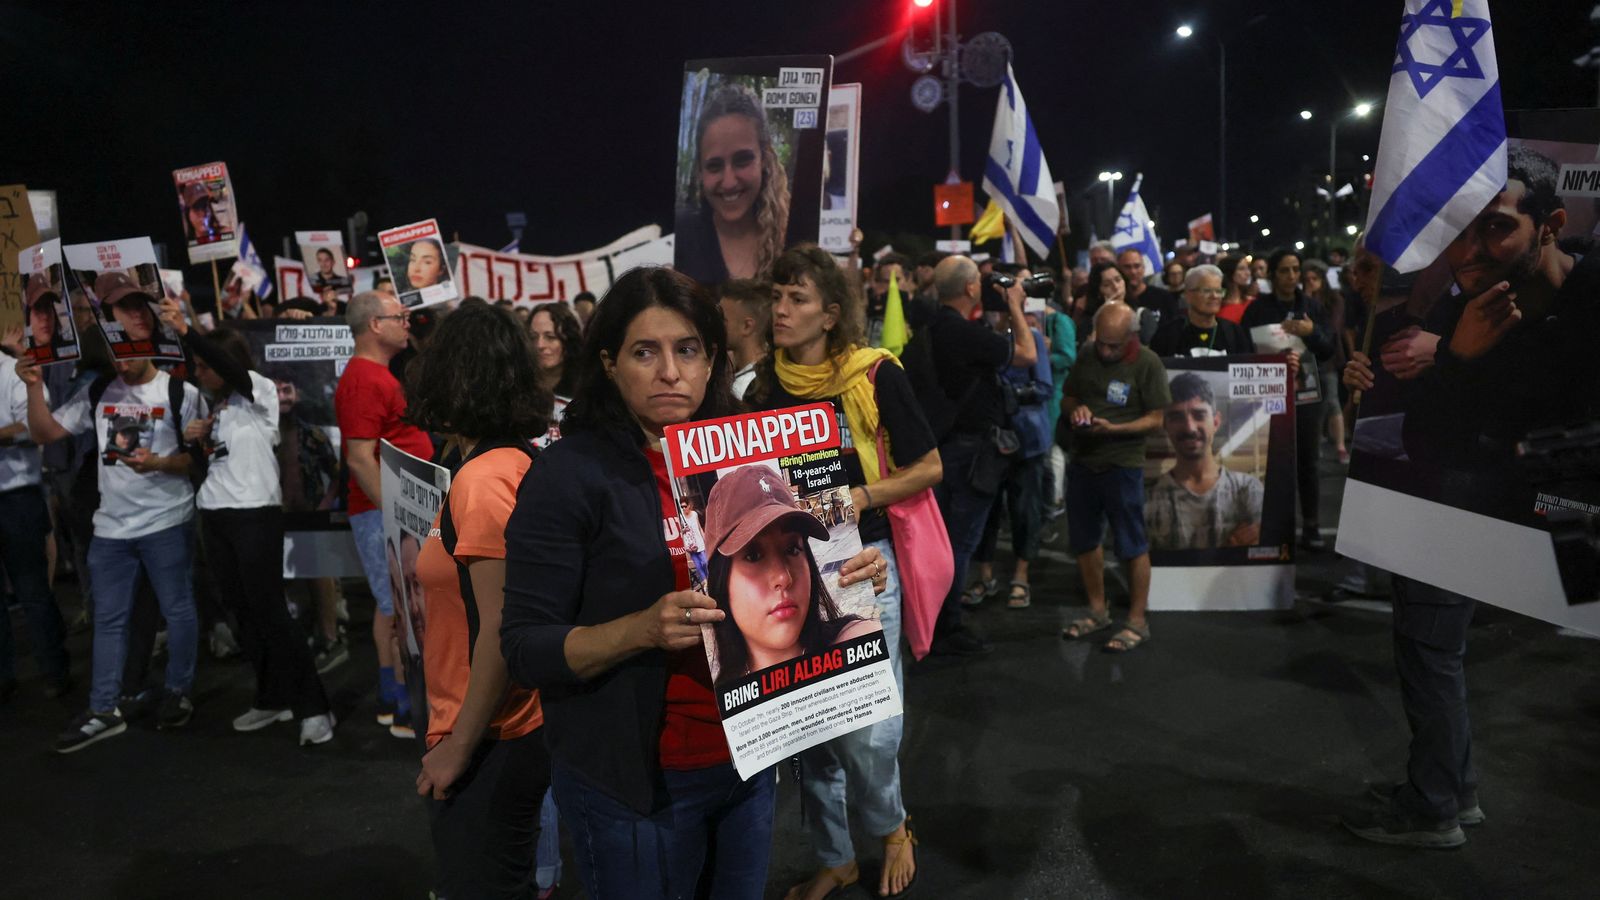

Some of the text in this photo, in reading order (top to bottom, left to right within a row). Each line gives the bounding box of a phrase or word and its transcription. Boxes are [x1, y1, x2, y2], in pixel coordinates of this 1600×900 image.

[782, 72, 821, 86] רומי גונן
[766, 91, 818, 105] ROMI GONEN
[796, 111, 816, 128] (23)
[267, 346, 291, 358] HERSH
[1232, 366, 1285, 380] אריאל קוניו
[1233, 384, 1256, 396] ARIEL
[1258, 383, 1284, 396] CUNIO
[1265, 399, 1284, 414] (26)
[677, 408, 831, 468] KIDNAPPED
[780, 448, 839, 468] #BringThemHome
[792, 461, 842, 480] 18-years-old
[806, 475, 832, 488] Israeli
[724, 638, 883, 711] BRING LIRI ALBAG BACK
[737, 717, 756, 727] October
[765, 707, 780, 715] nearly
[790, 694, 813, 705] innocent
[813, 686, 835, 696] civilians
[849, 673, 873, 684] abducted
[738, 728, 751, 736] Israel
[768, 715, 781, 723] Gaza
[794, 704, 806, 712] Their
[807, 693, 838, 707] whereabouts
[839, 687, 856, 696] remain
[735, 743, 747, 751] More
[757, 731, 771, 740] 3,000
[838, 698, 858, 709] ranging
[739, 749, 754, 758] months
[765, 738, 778, 747] years
[765, 745, 782, 754] brutally
[782, 734, 806, 746] separated
[818, 724, 832, 732] loved
